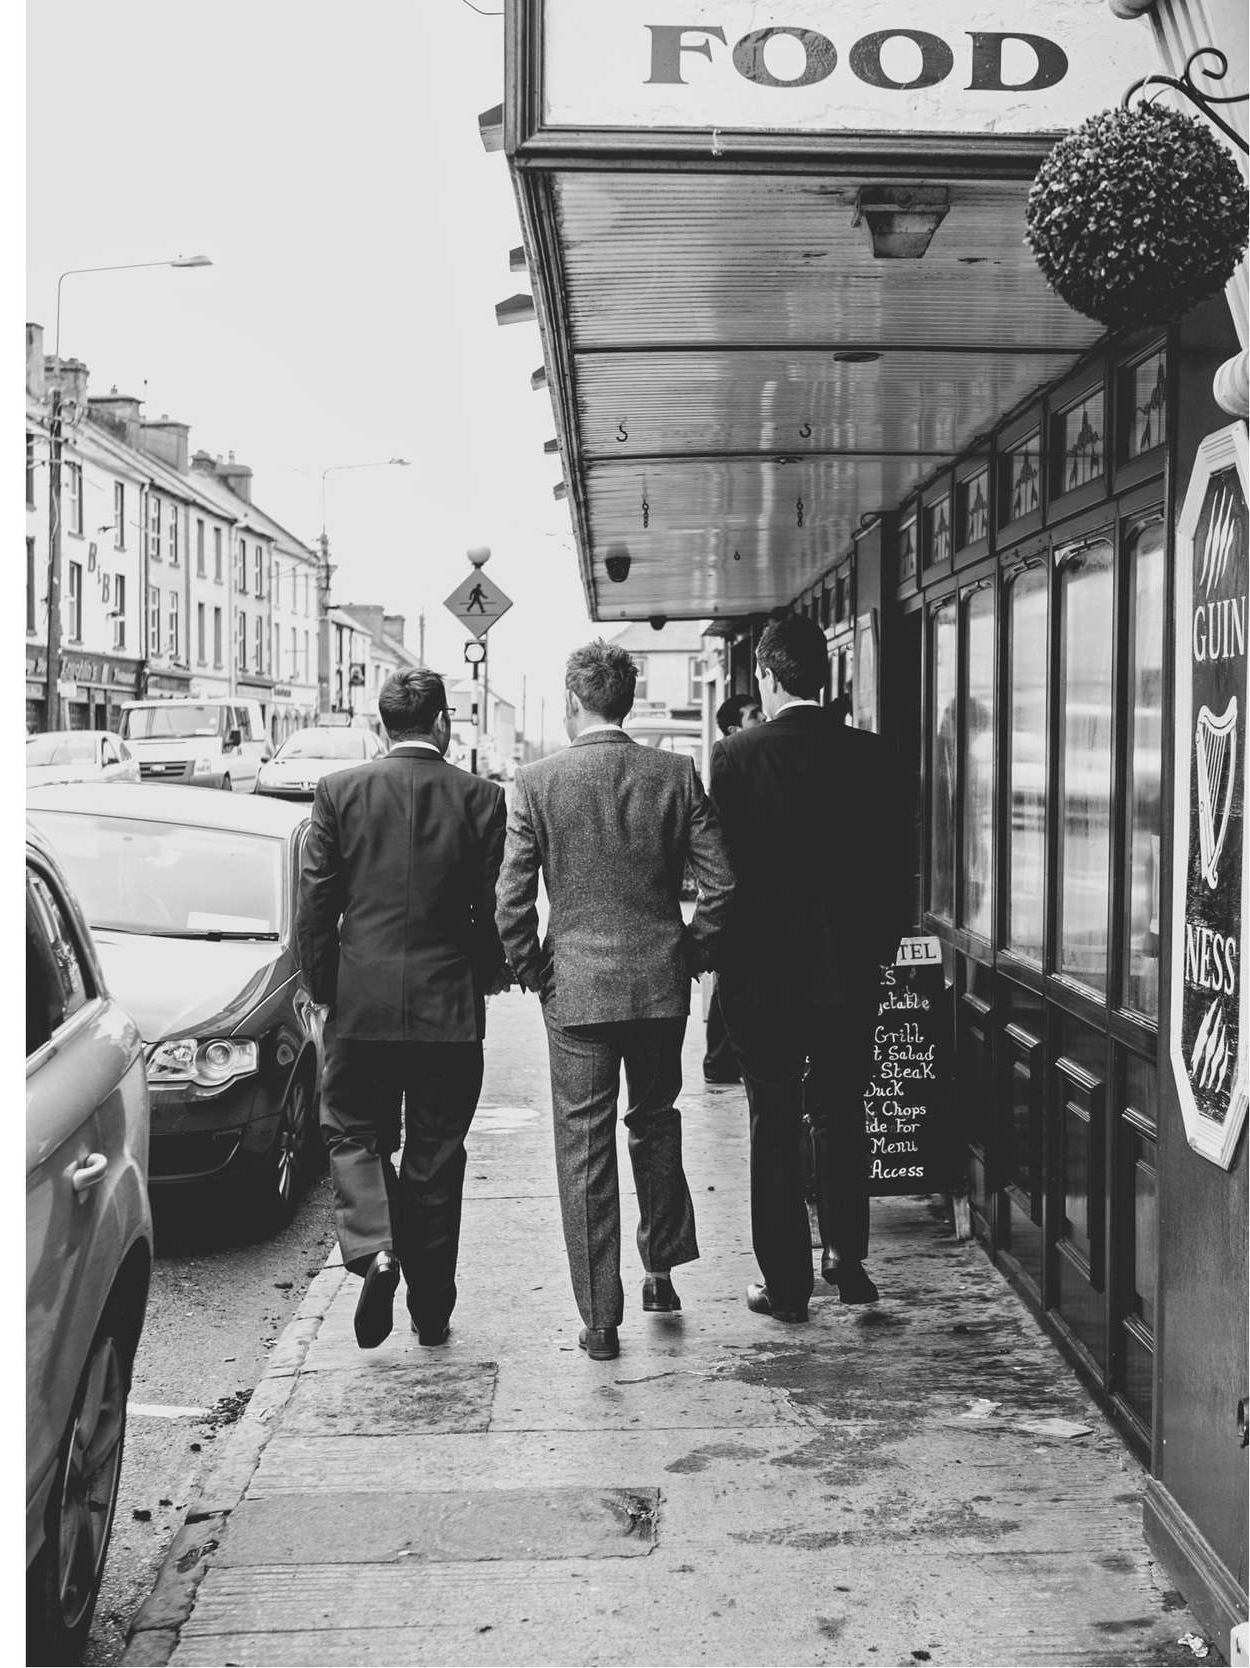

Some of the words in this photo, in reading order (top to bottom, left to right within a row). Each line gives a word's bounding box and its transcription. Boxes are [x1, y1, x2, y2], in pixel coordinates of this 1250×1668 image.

[643, 24, 1069, 92] FOOD
[1193, 596, 1247, 662] GUIN
[898, 942, 938, 961] TEL
[1185, 923, 1236, 996] NESS
[874, 1022, 925, 1044] Grill
[888, 1044, 937, 1061] Salad
[881, 1100, 927, 1120] Chops
[894, 1118, 921, 1133] For
[870, 1136, 919, 1155] Menu
[869, 1159, 925, 1180] Access
